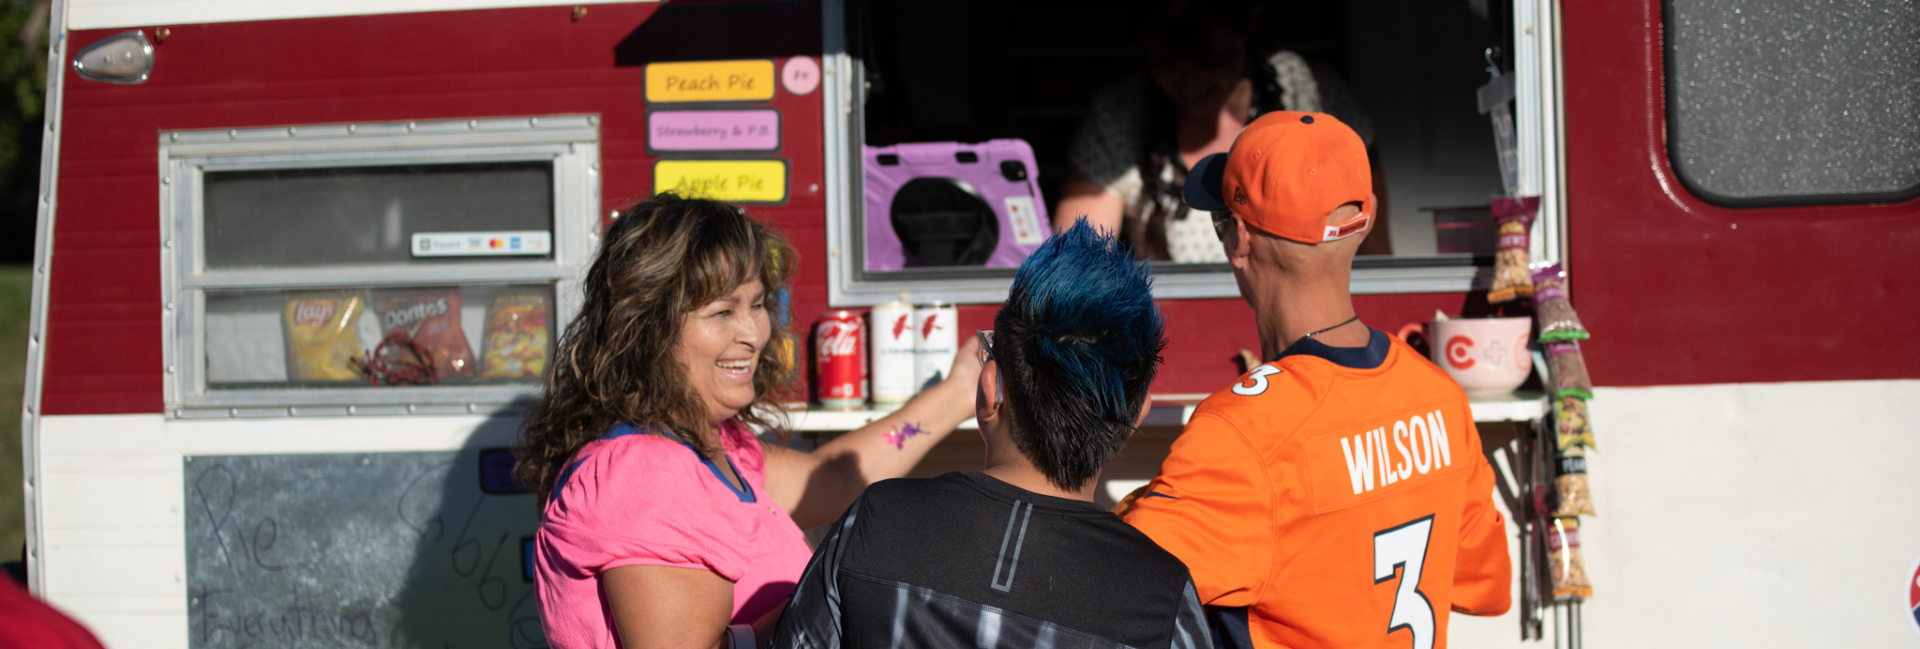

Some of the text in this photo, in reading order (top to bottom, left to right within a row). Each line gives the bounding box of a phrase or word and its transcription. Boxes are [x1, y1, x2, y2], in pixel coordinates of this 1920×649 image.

[665, 72, 756, 92] Peach Pie
[656, 122, 727, 140] Strawberry
[731, 125, 743, 137] &
[675, 172, 765, 195] Apple Pie
[384, 297, 449, 330] Doritos
[1231, 364, 1283, 396] 3
[1340, 409, 1451, 495] WILSON
[194, 464, 288, 572] Pie
[1373, 513, 1436, 649] 3
